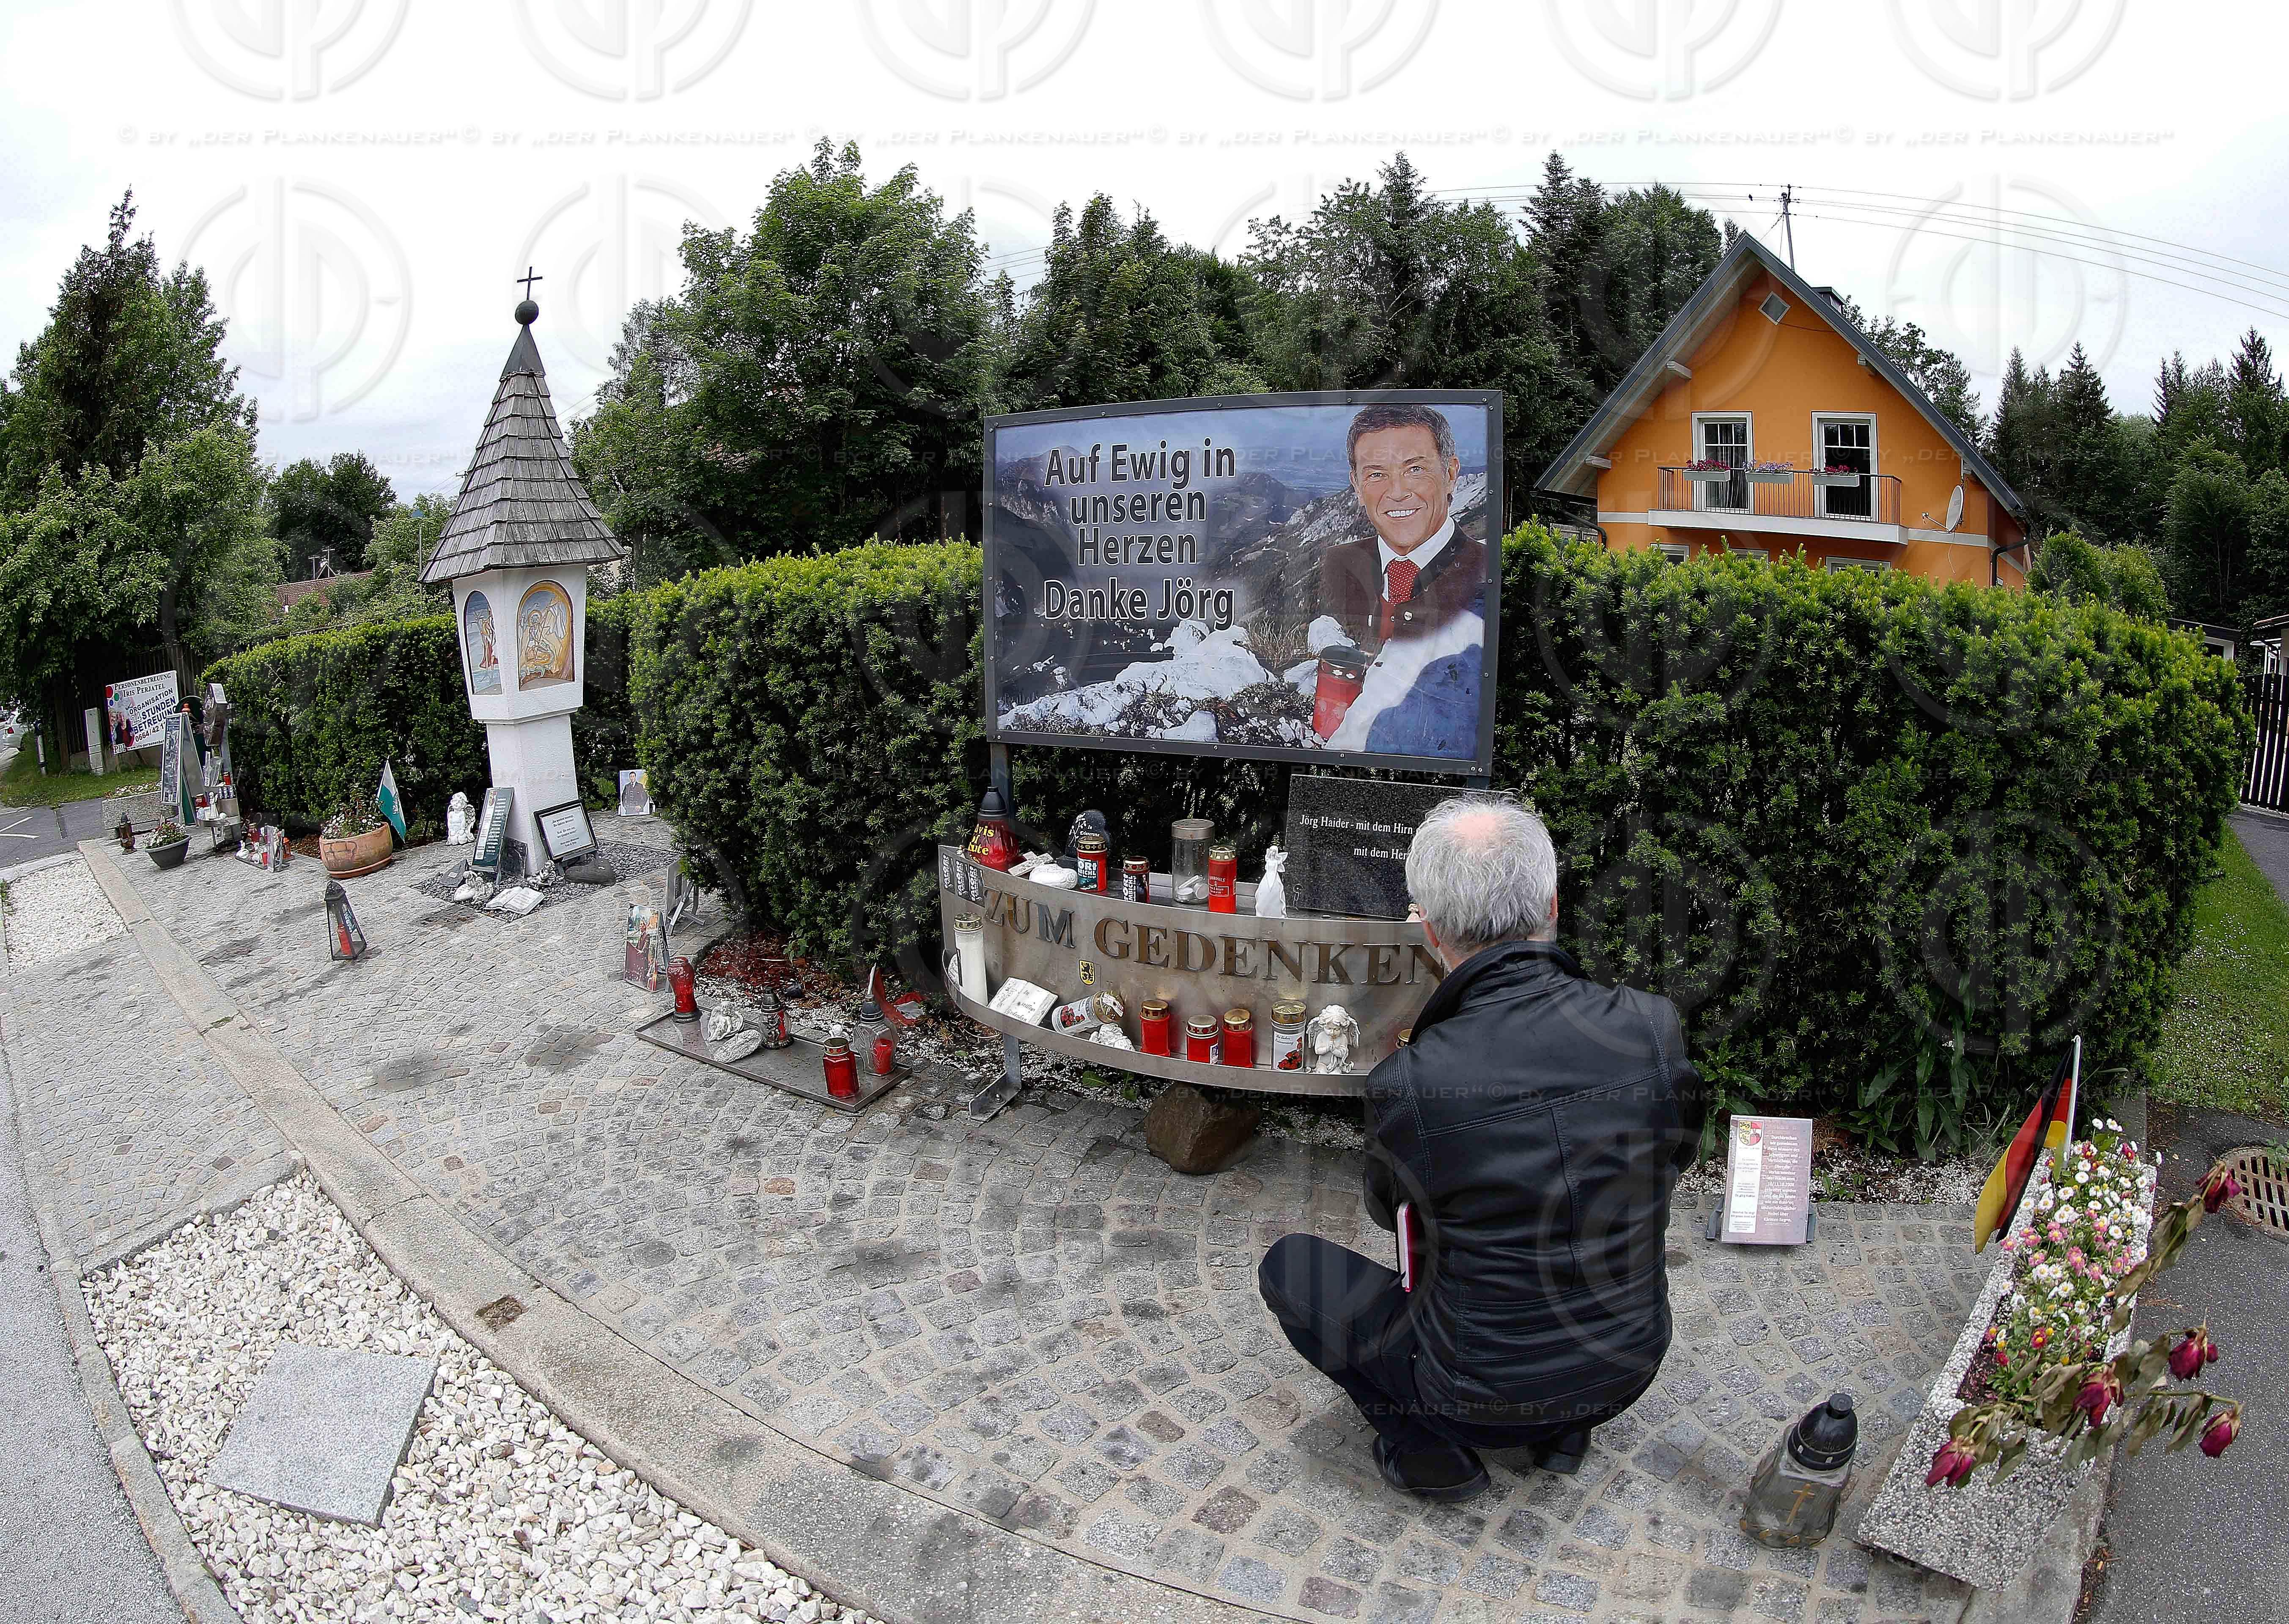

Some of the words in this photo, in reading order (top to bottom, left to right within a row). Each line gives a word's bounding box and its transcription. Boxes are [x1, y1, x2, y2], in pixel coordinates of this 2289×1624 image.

[1044, 443, 1101, 487] Auf
[1111, 439, 1191, 490] Ewig
[1203, 436, 1236, 478] in
[1070, 490, 1206, 525] unseren
[1078, 527, 1197, 566] Herzen
[1044, 576, 1148, 620] Danke
[1156, 577, 1235, 631] Jörg
[129, 688, 173, 714] ORGANISATION
[131, 713, 142, 726] 24
[142, 696, 176, 719] STUNDEN
[1300, 815, 1318, 828] Jörg
[1321, 816, 1349, 828] Haider
[1356, 820, 1370, 831] mit
[1372, 822, 1390, 832] dem
[1393, 823, 1413, 834] Hirn
[1354, 846, 1368, 856] mit
[1370, 847, 1388, 858] dem
[982, 885, 1076, 949] ZUM
[1093, 917, 1445, 985] GEDENKEN
